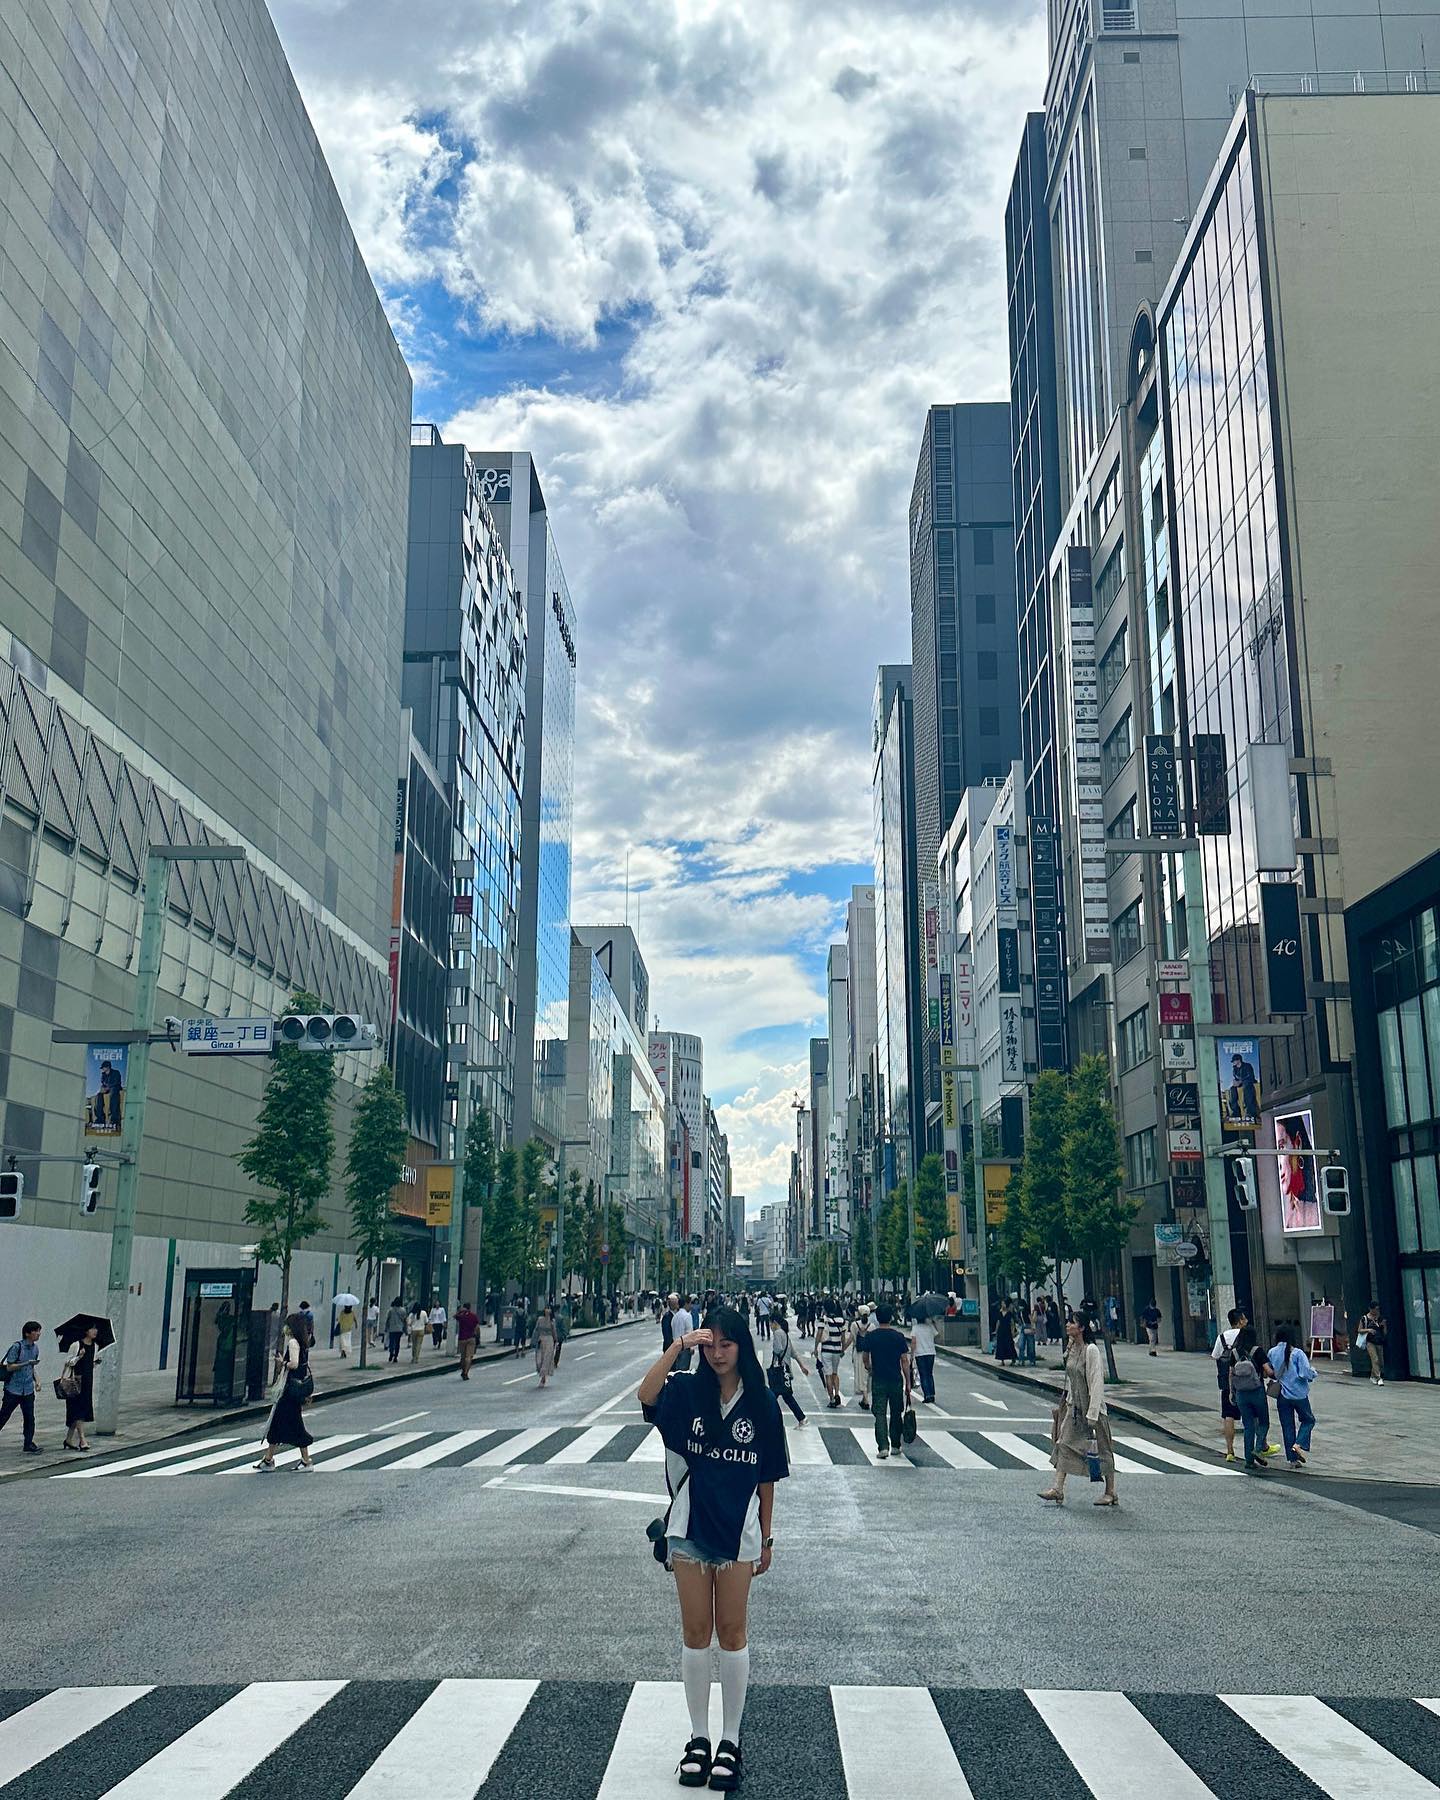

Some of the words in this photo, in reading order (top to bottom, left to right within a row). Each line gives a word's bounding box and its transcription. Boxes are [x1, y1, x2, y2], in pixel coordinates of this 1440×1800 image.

[1151, 760, 1163, 818] SALON
[1164, 760, 1176, 818] GINZA
[1036, 823, 1048, 833] M
[959, 963, 970, 1027] エニマリ
[187, 1018, 213, 1027] 中央区
[187, 1026, 267, 1041] 銀座一丁目
[1002, 1006, 1018, 1072] 椿屋珈琲店
[211, 1040, 234, 1049] Ginza
[94, 1053, 123, 1061] TIGER
[944, 1050, 953, 1078] ELIE
[722, 1449, 758, 1465] CLUB
